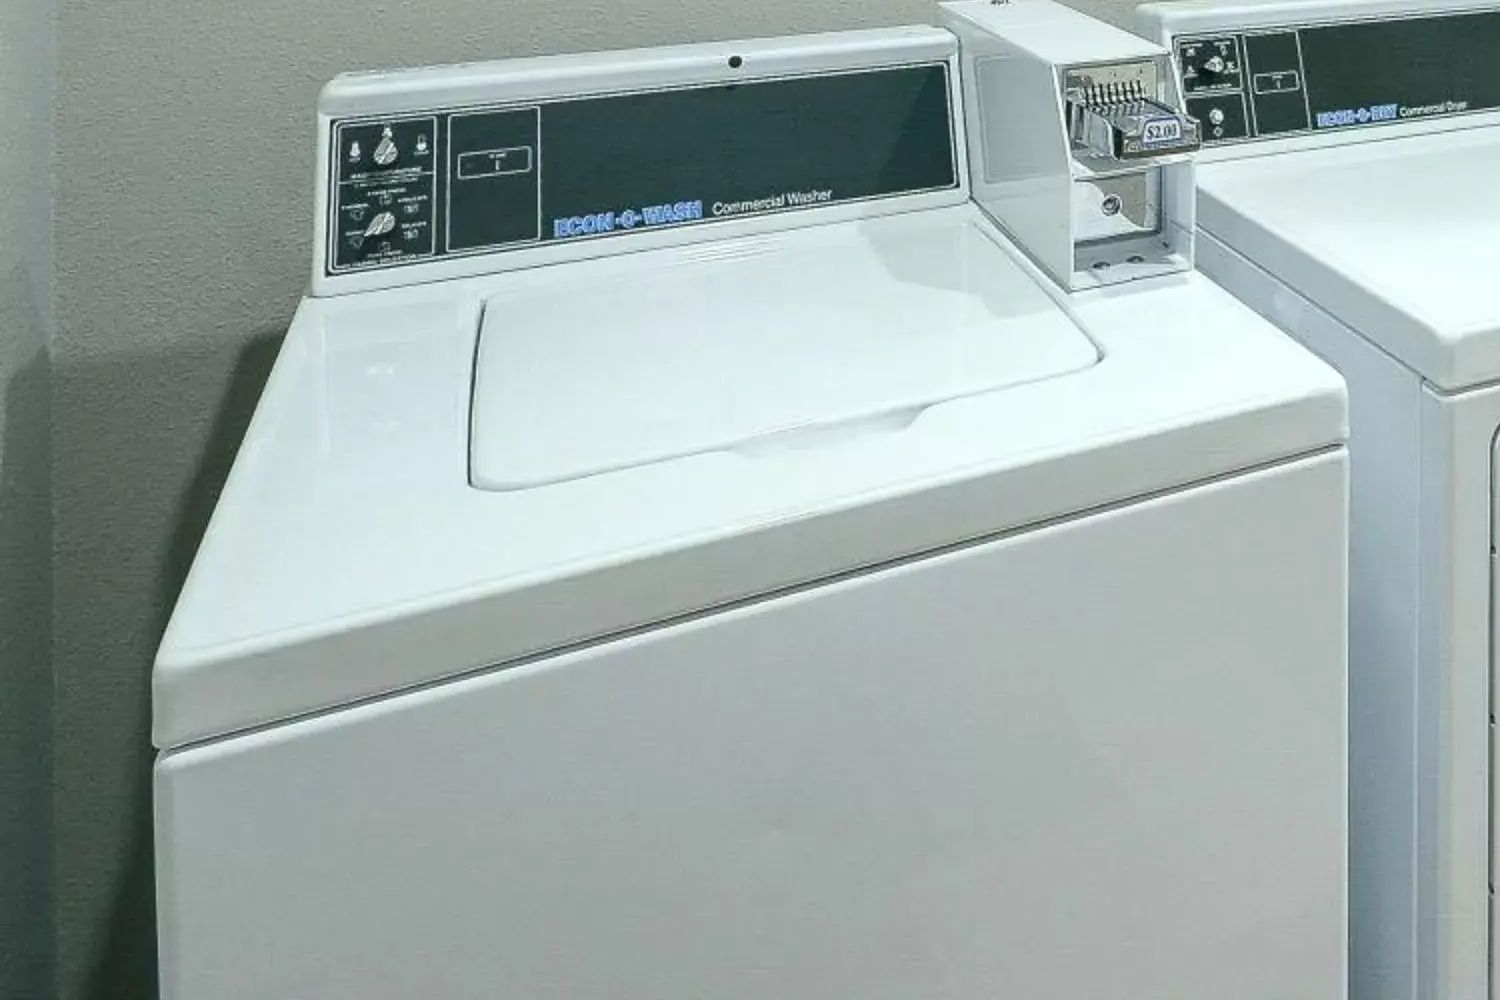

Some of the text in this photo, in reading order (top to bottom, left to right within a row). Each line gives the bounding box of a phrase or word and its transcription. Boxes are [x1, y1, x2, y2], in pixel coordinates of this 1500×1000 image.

[1400, 103, 1446, 117] Commercial
[1446, 101, 1468, 112] Dryer
[1147, 123, 1177, 139] $2.00
[554, 189, 832, 239] ECON-O-WASH Commercial Washer
